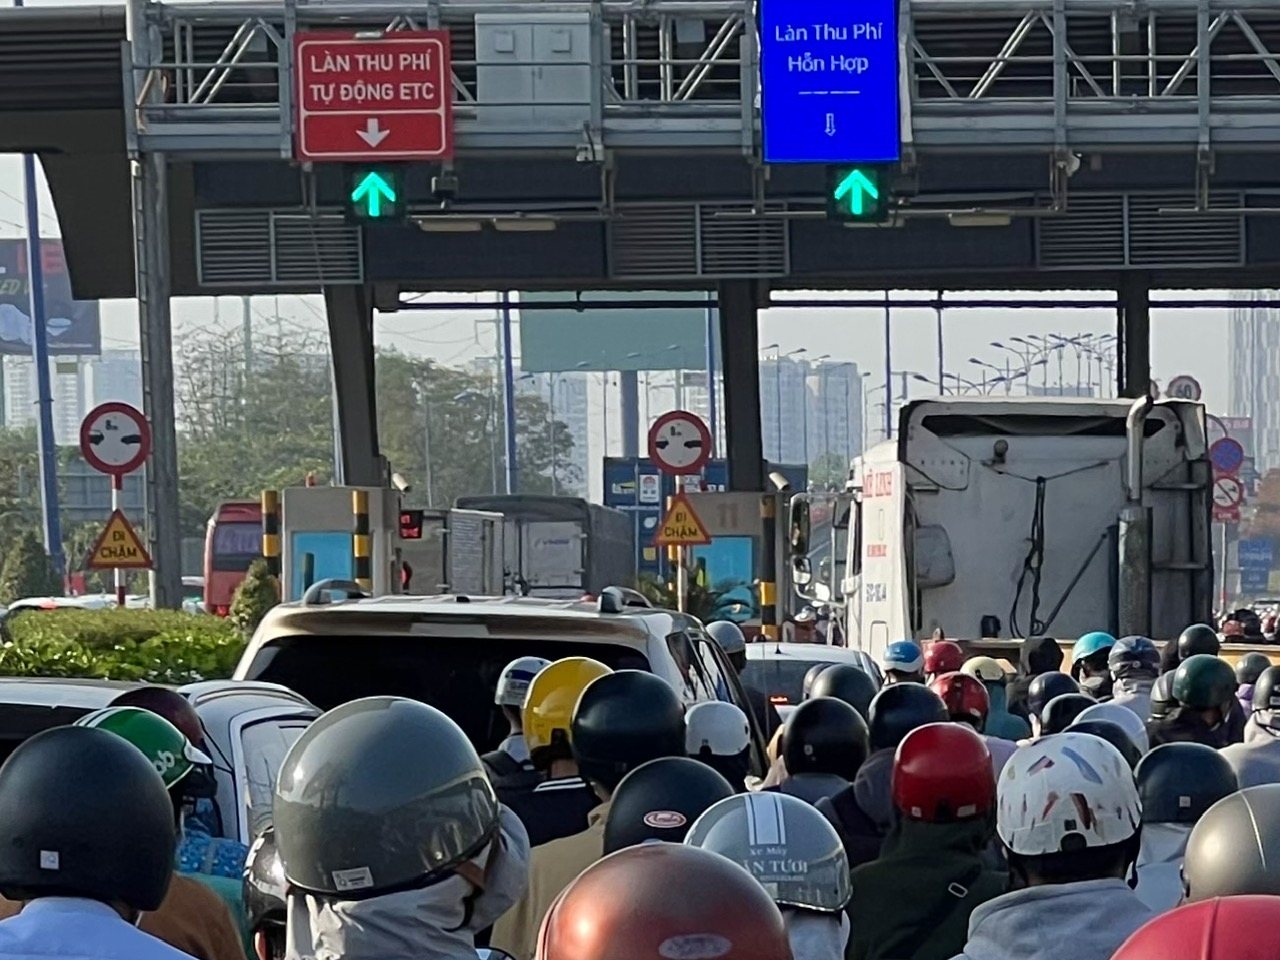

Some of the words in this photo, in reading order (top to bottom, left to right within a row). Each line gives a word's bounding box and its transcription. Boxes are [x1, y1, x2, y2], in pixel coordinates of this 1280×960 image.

[812, 23, 847, 41] Thu
[853, 22, 884, 40] Phí
[311, 50, 350, 73] LÀN
[355, 53, 394, 71] THU
[399, 49, 432, 71] PHÍ
[831, 54, 869, 74] Hợp
[309, 83, 335, 105] TỰ
[340, 79, 394, 104] ĐỘNG
[399, 82, 435, 101] ETC
